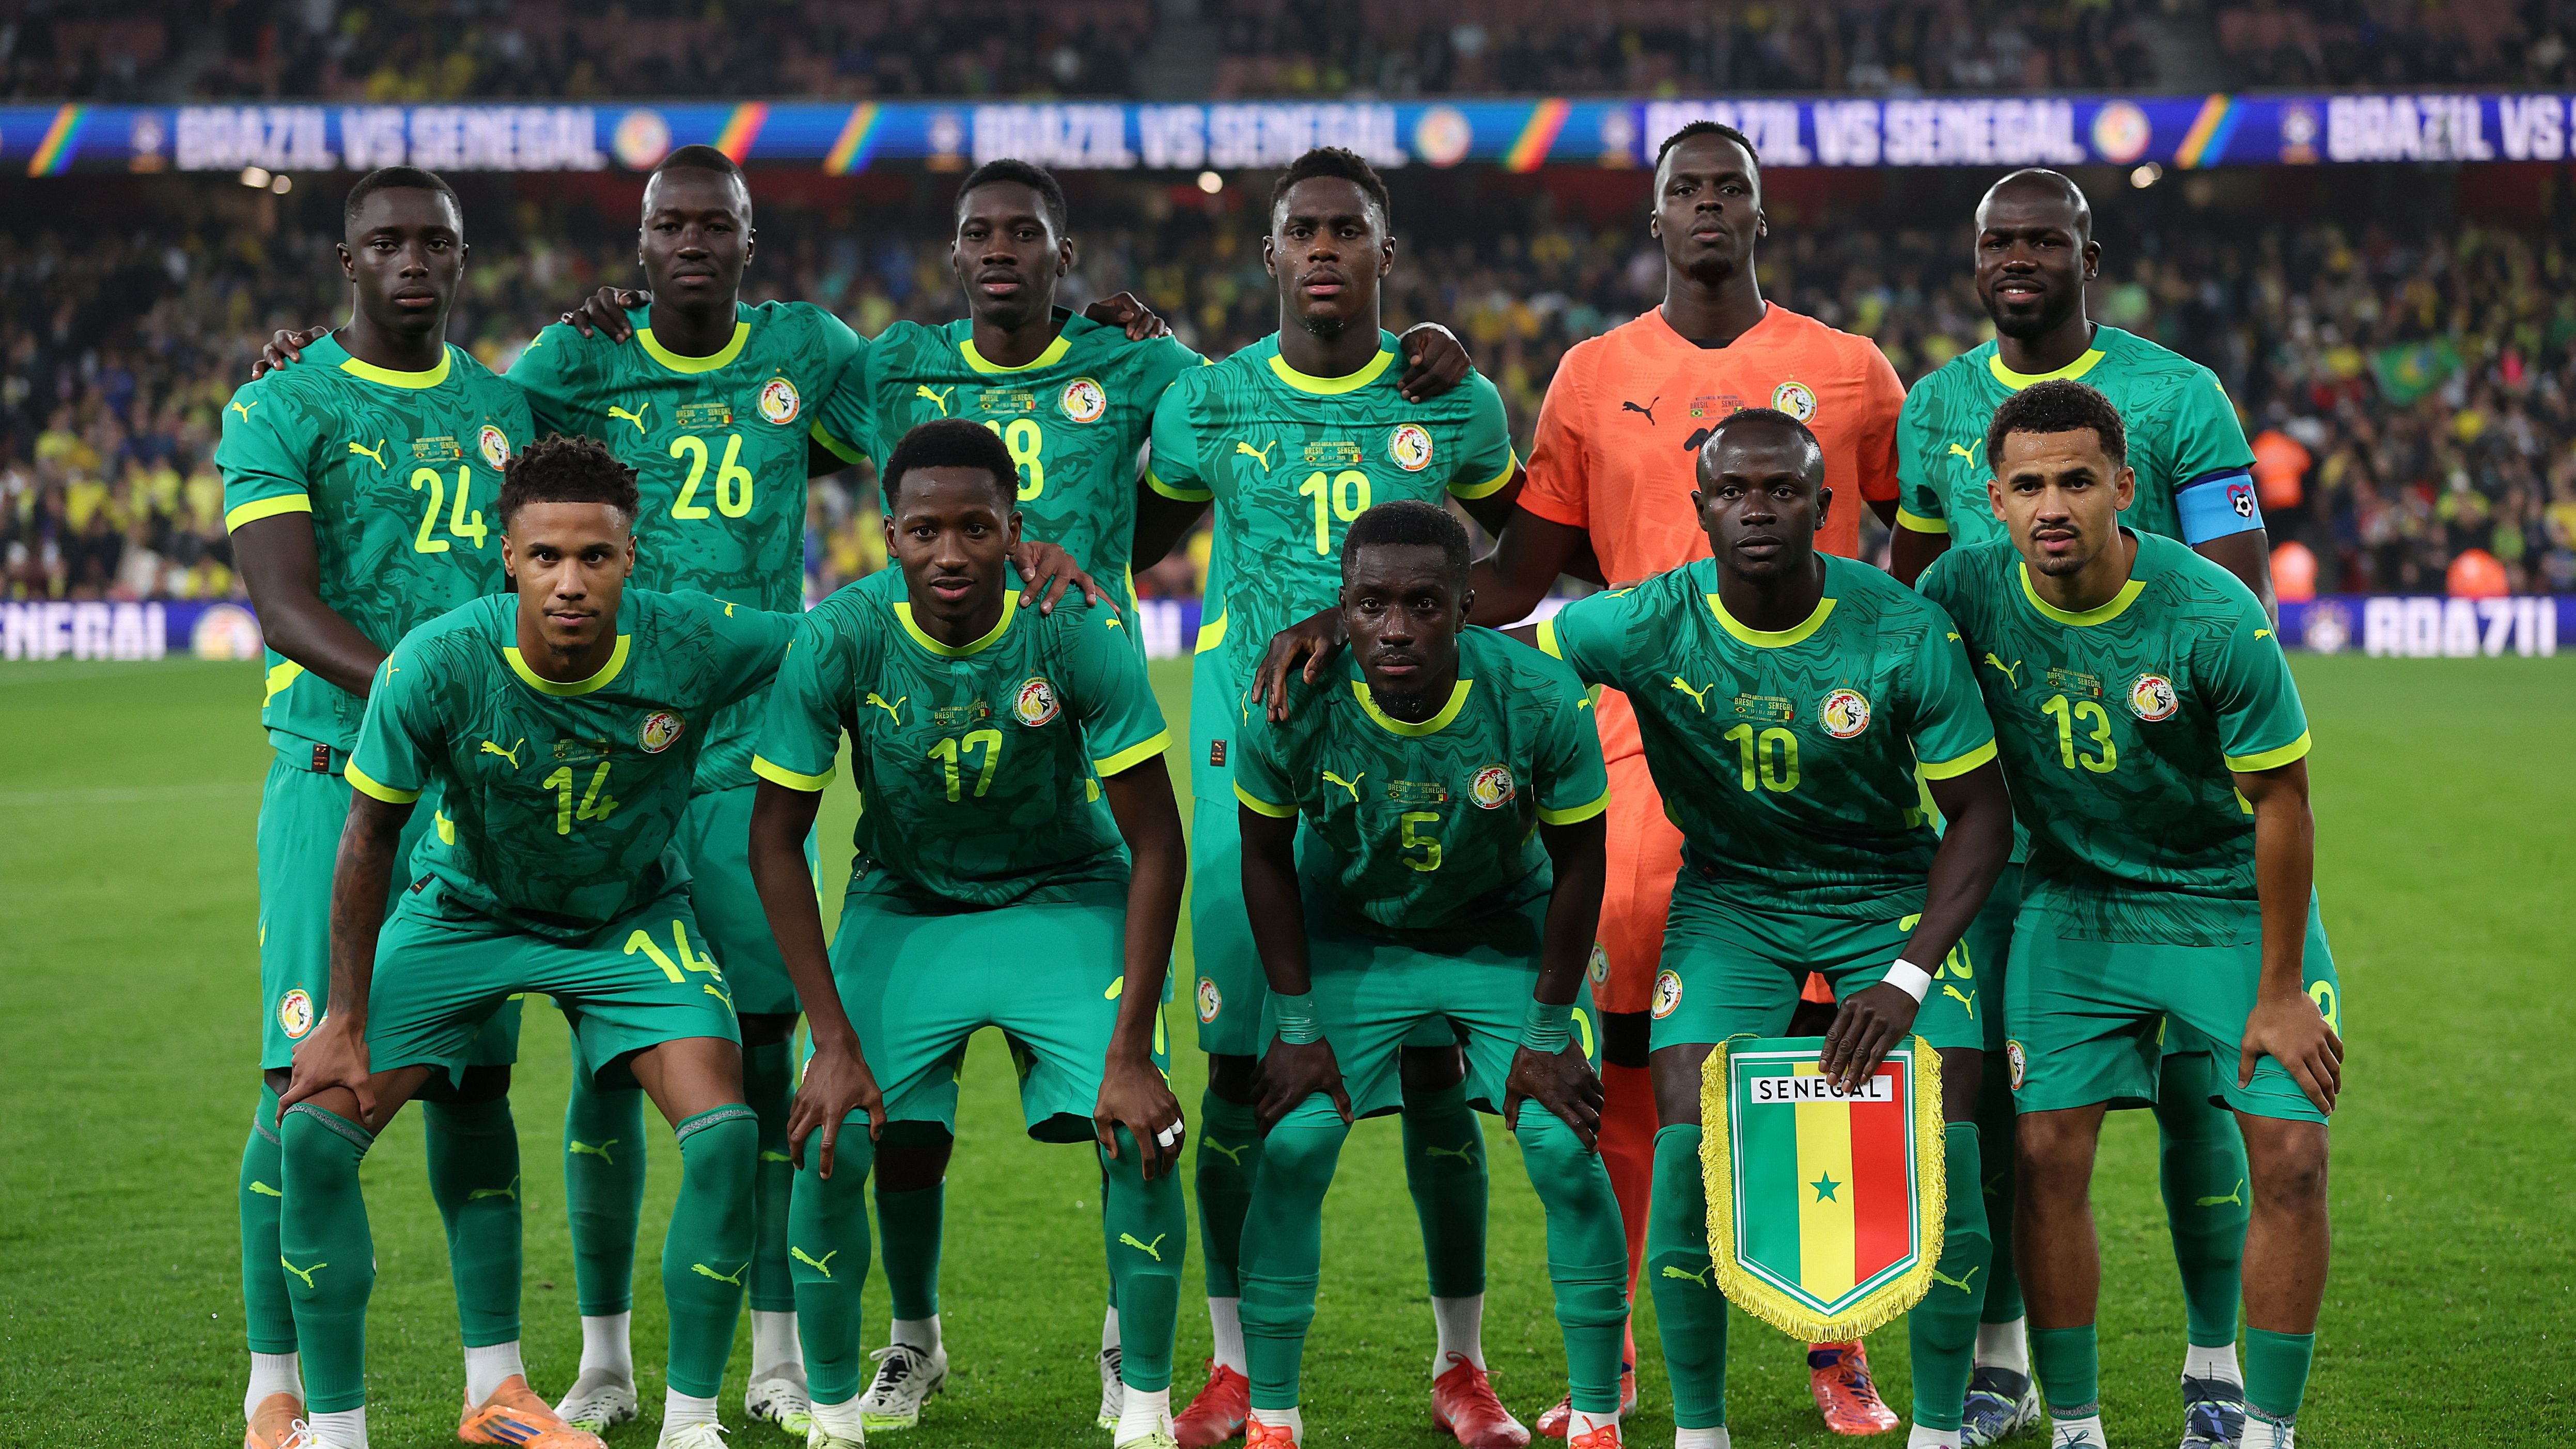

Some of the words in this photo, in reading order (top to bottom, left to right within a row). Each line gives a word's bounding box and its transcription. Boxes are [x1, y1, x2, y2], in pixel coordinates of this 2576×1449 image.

[176, 105, 337, 172] BRAZIL
[341, 105, 406, 172] VS
[410, 106, 610, 172] SENEGAL
[972, 105, 1135, 169] BRAZIL
[1139, 105, 1206, 169] VS
[1209, 105, 1410, 169] SENEGAL
[1813, 101, 1879, 166] VS
[1883, 101, 2087, 165] SENEGAL
[2328, 96, 2494, 161] BRAZIL
[2499, 96, 2565, 161] VS
[670, 433, 753, 519] 26
[984, 418, 1043, 501] 8
[411, 465, 488, 553] 24
[1299, 470, 1371, 555] 19
[1735, 697, 1754, 707] BRESIL
[1768, 702, 1793, 711] SENEGAL
[2047, 672, 2066, 680] BRESIL
[2078, 677, 2101, 688] SENEGAL
[1724, 723, 1800, 792] 10
[1837, 726, 1864, 737] FOOTBALL
[2042, 694, 2117, 773] 13
[543, 761, 619, 834] 14
[928, 729, 1003, 802] 17
[1388, 784, 1408, 792] BRESIL
[1401, 812, 1441, 871] 5
[623, 920, 722, 983] 14
[1759, 1079, 1881, 1100] SENEGAL
